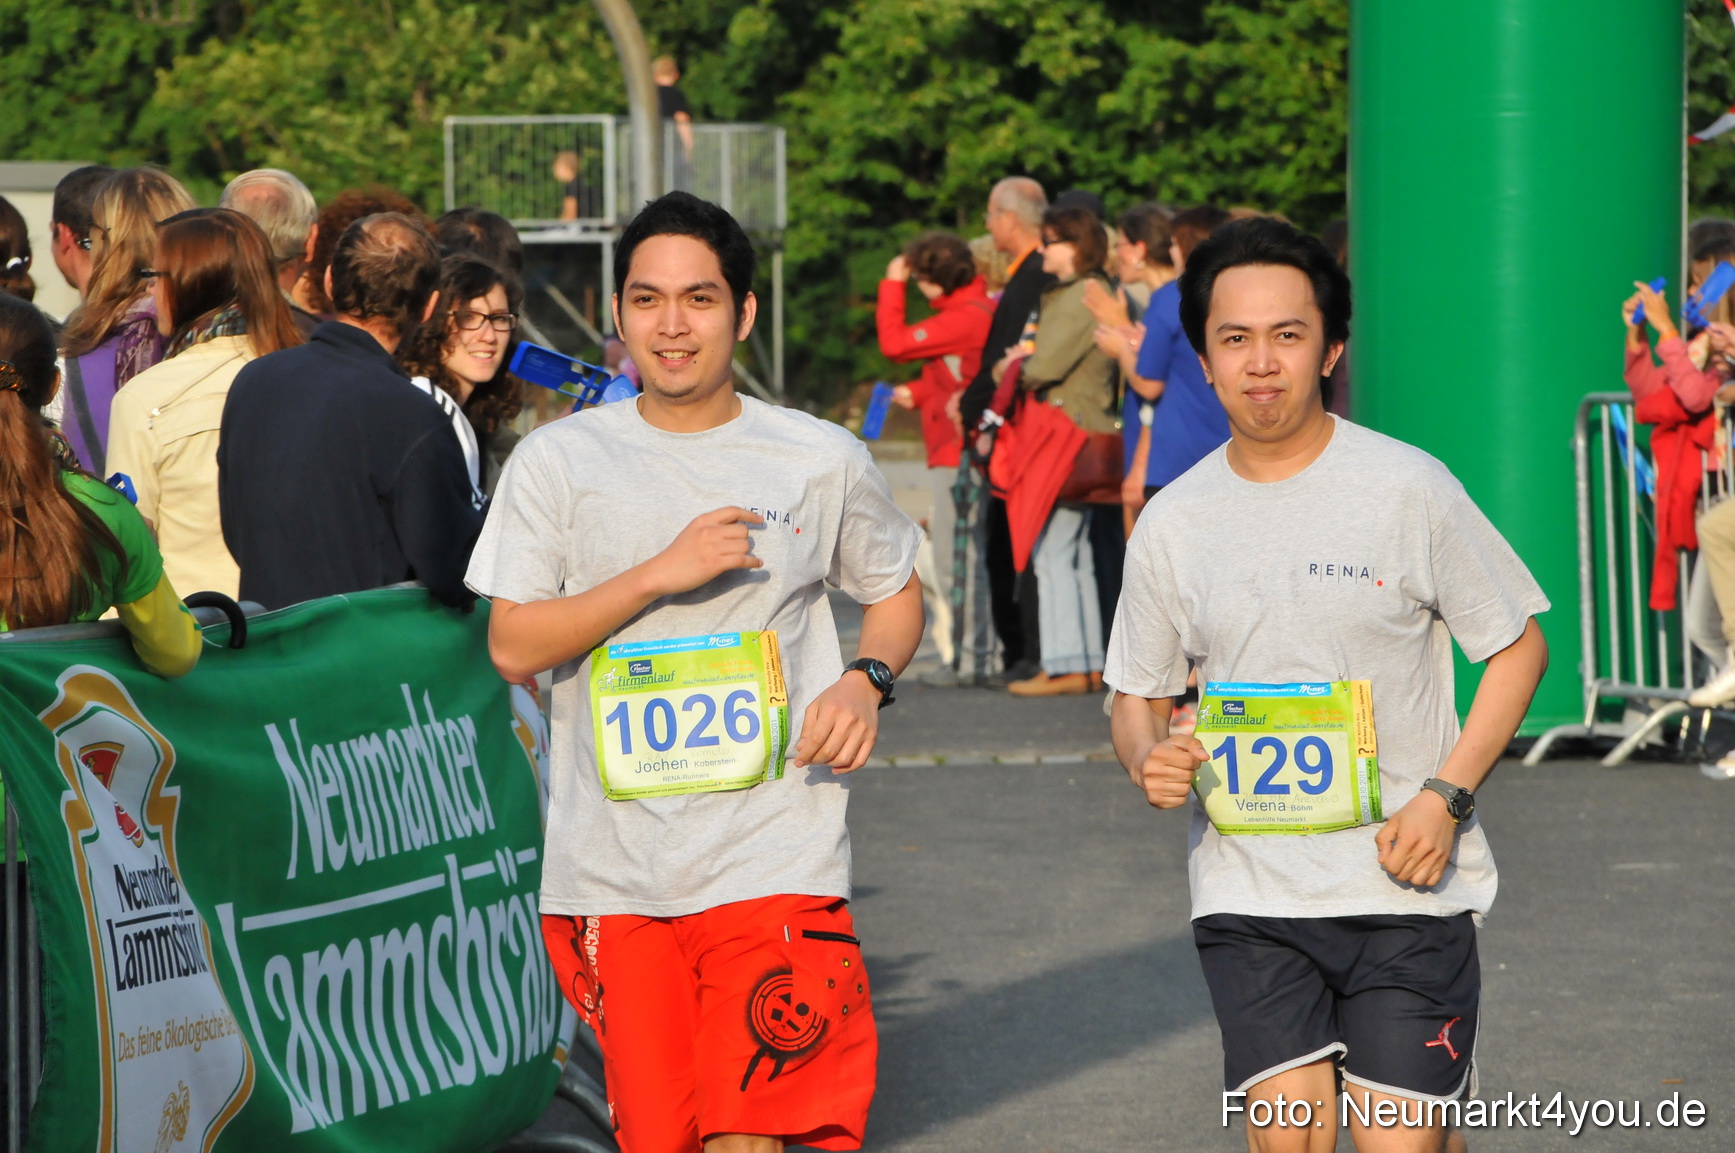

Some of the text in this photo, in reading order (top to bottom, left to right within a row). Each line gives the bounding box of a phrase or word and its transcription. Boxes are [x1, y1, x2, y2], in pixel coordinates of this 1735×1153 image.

[618, 669, 676, 688] firmenlauf
[605, 688, 761, 756] 1026
[1212, 713, 1267, 725] firmenlauf
[634, 757, 737, 774] Jochen Koberstein
[1212, 735, 1334, 795] 129
[265, 683, 496, 880] Neumarkter
[662, 772, 710, 782] RENA-Runners
[1235, 798, 1313, 812] Verena Böhm
[117, 1031, 135, 1063] Das
[136, 1025, 163, 1057] feine
[164, 1010, 226, 1053] ökologische
